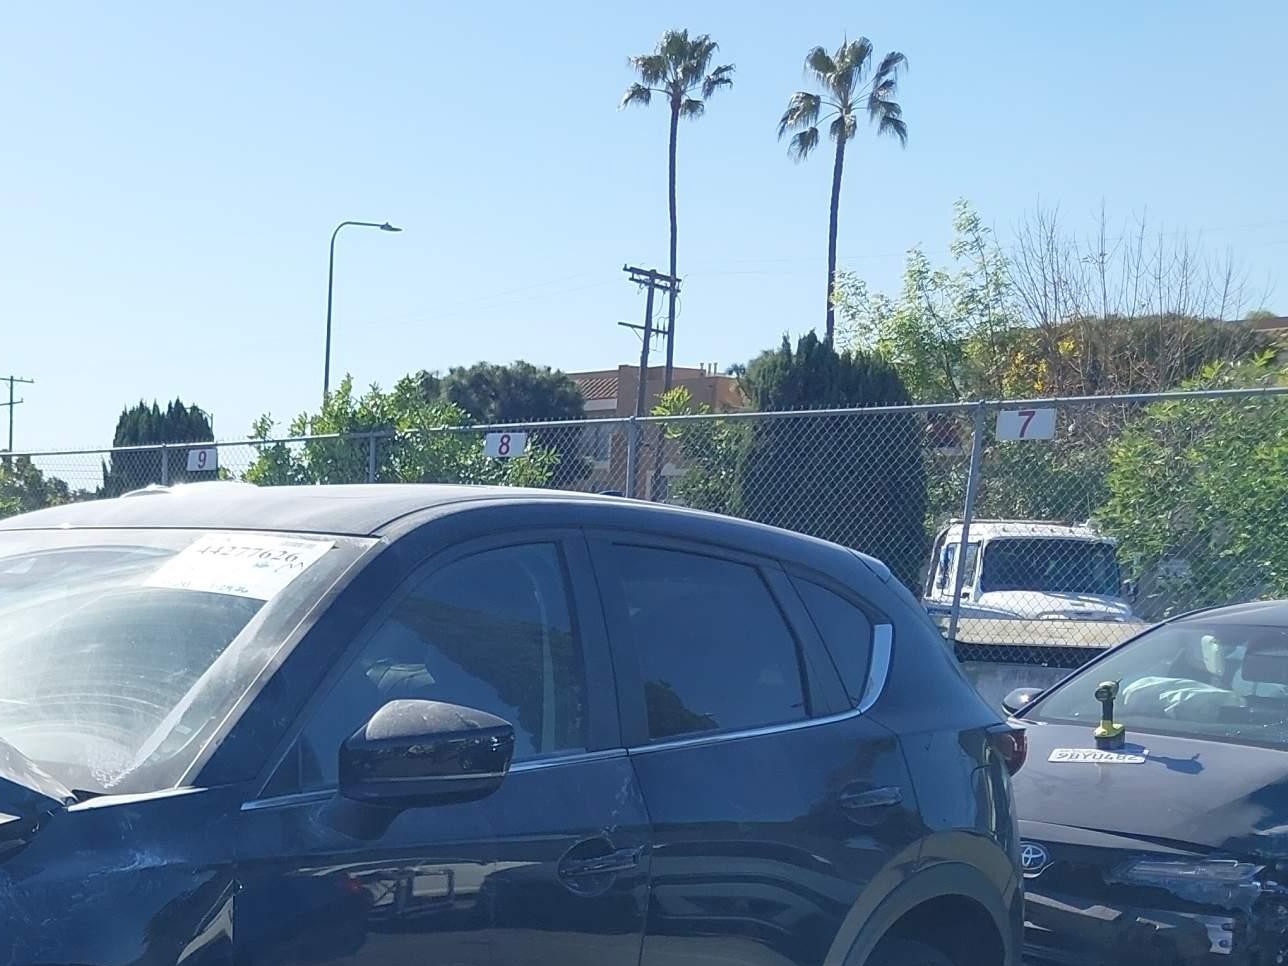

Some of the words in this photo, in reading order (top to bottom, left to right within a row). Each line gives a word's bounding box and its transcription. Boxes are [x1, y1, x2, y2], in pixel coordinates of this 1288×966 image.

[1017, 410, 1036, 438] 7
[498, 434, 511, 456] 8
[197, 450, 207, 469] 9
[198, 545, 299, 562] 44277626
